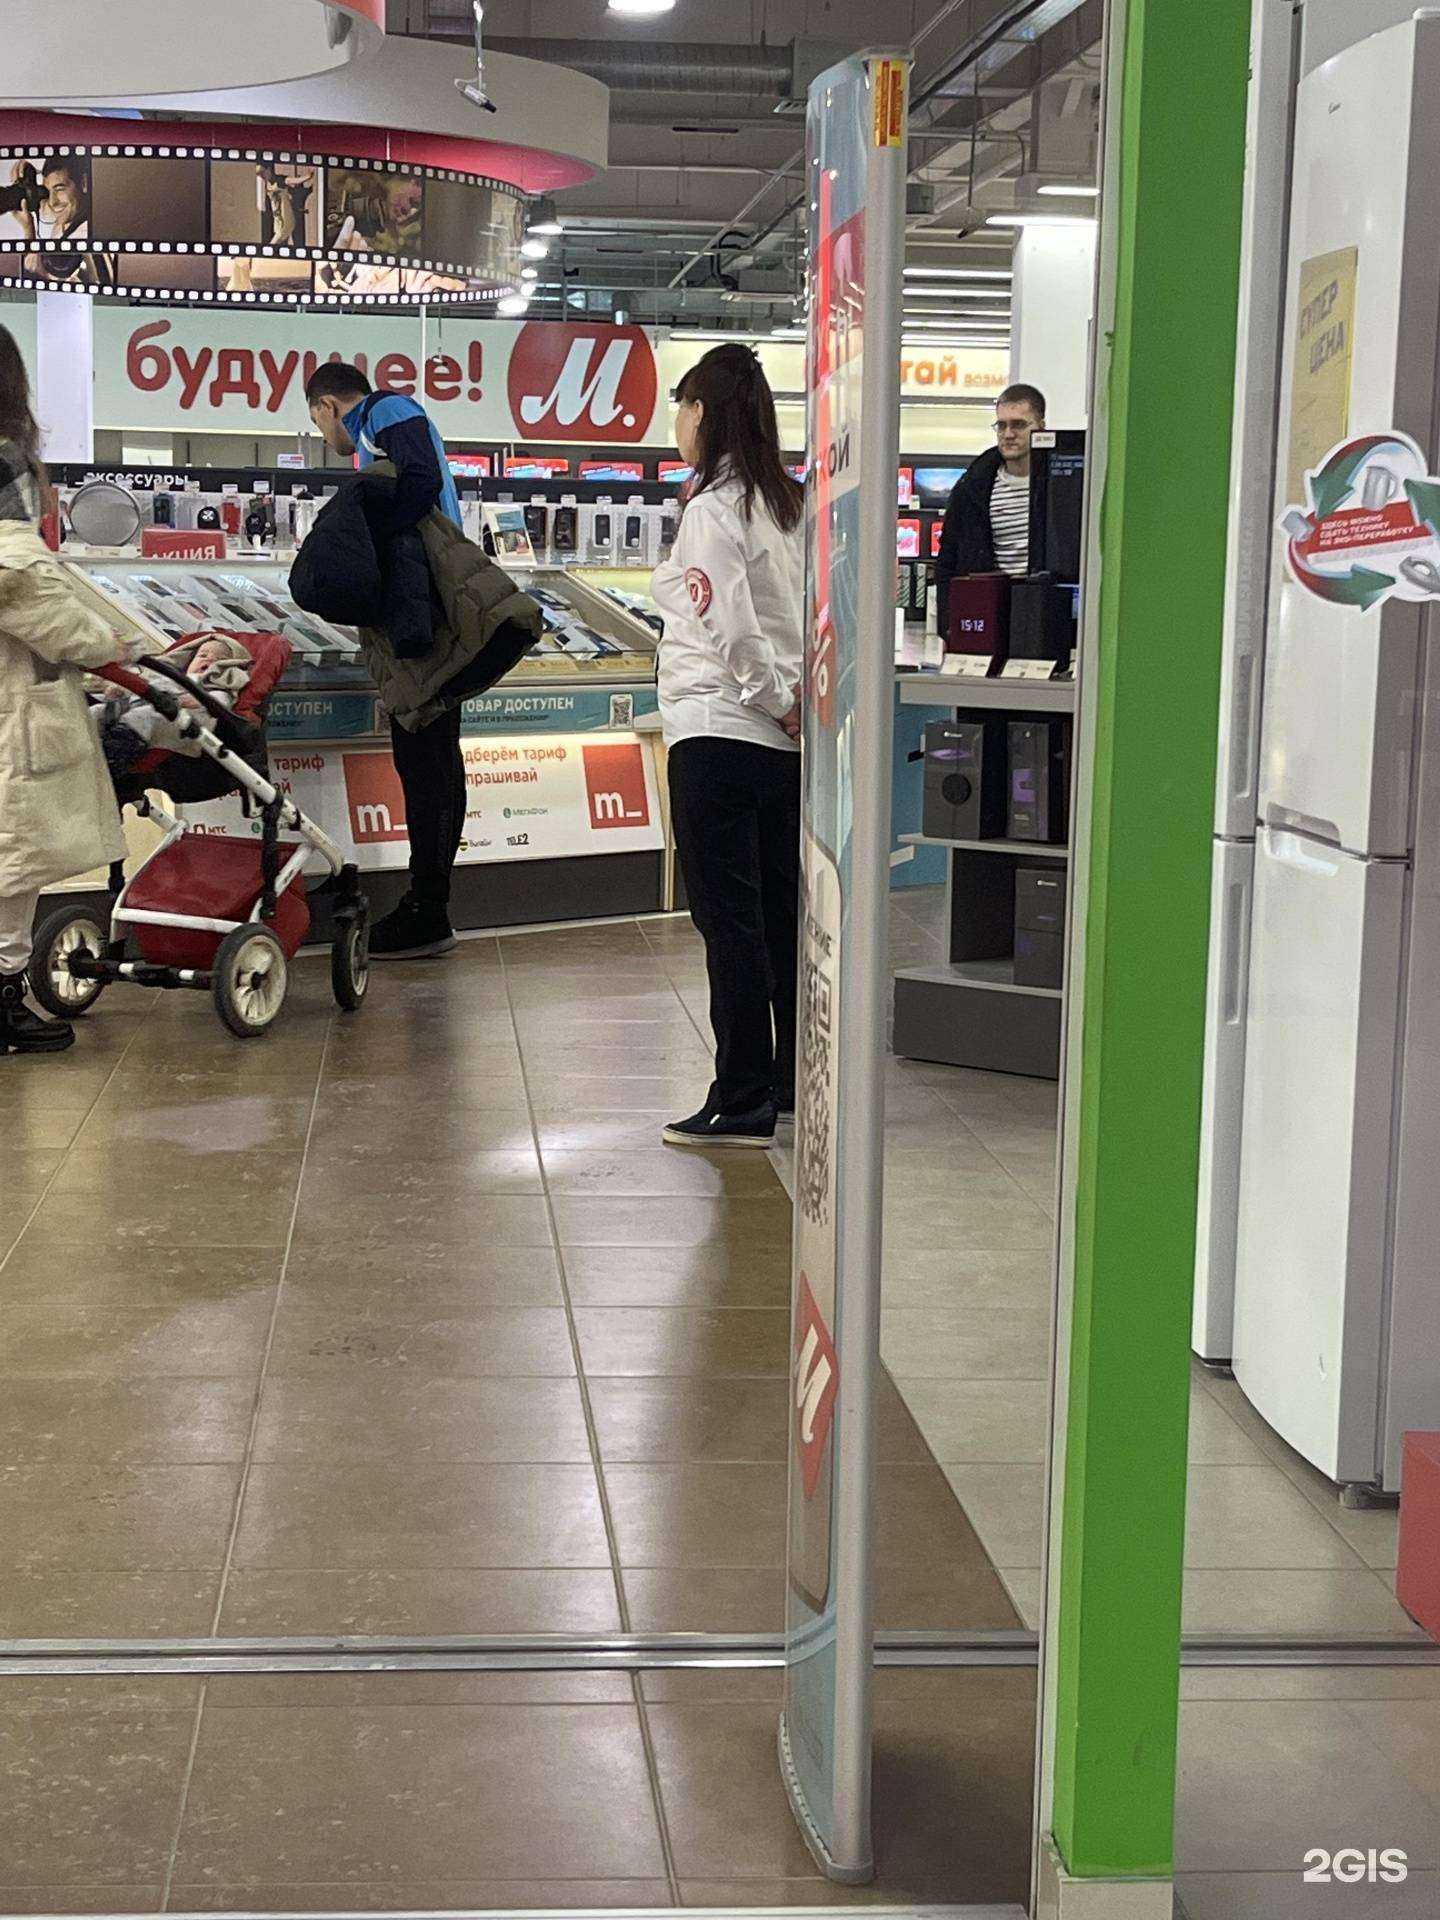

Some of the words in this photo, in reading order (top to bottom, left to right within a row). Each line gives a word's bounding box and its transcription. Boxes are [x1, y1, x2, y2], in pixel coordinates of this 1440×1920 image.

[152, 545, 216, 561] КЦИЯ
[504, 696, 574, 714] ДОСТУПЕН
[523, 745, 567, 762] тариф
[274, 753, 325, 772] тариф
